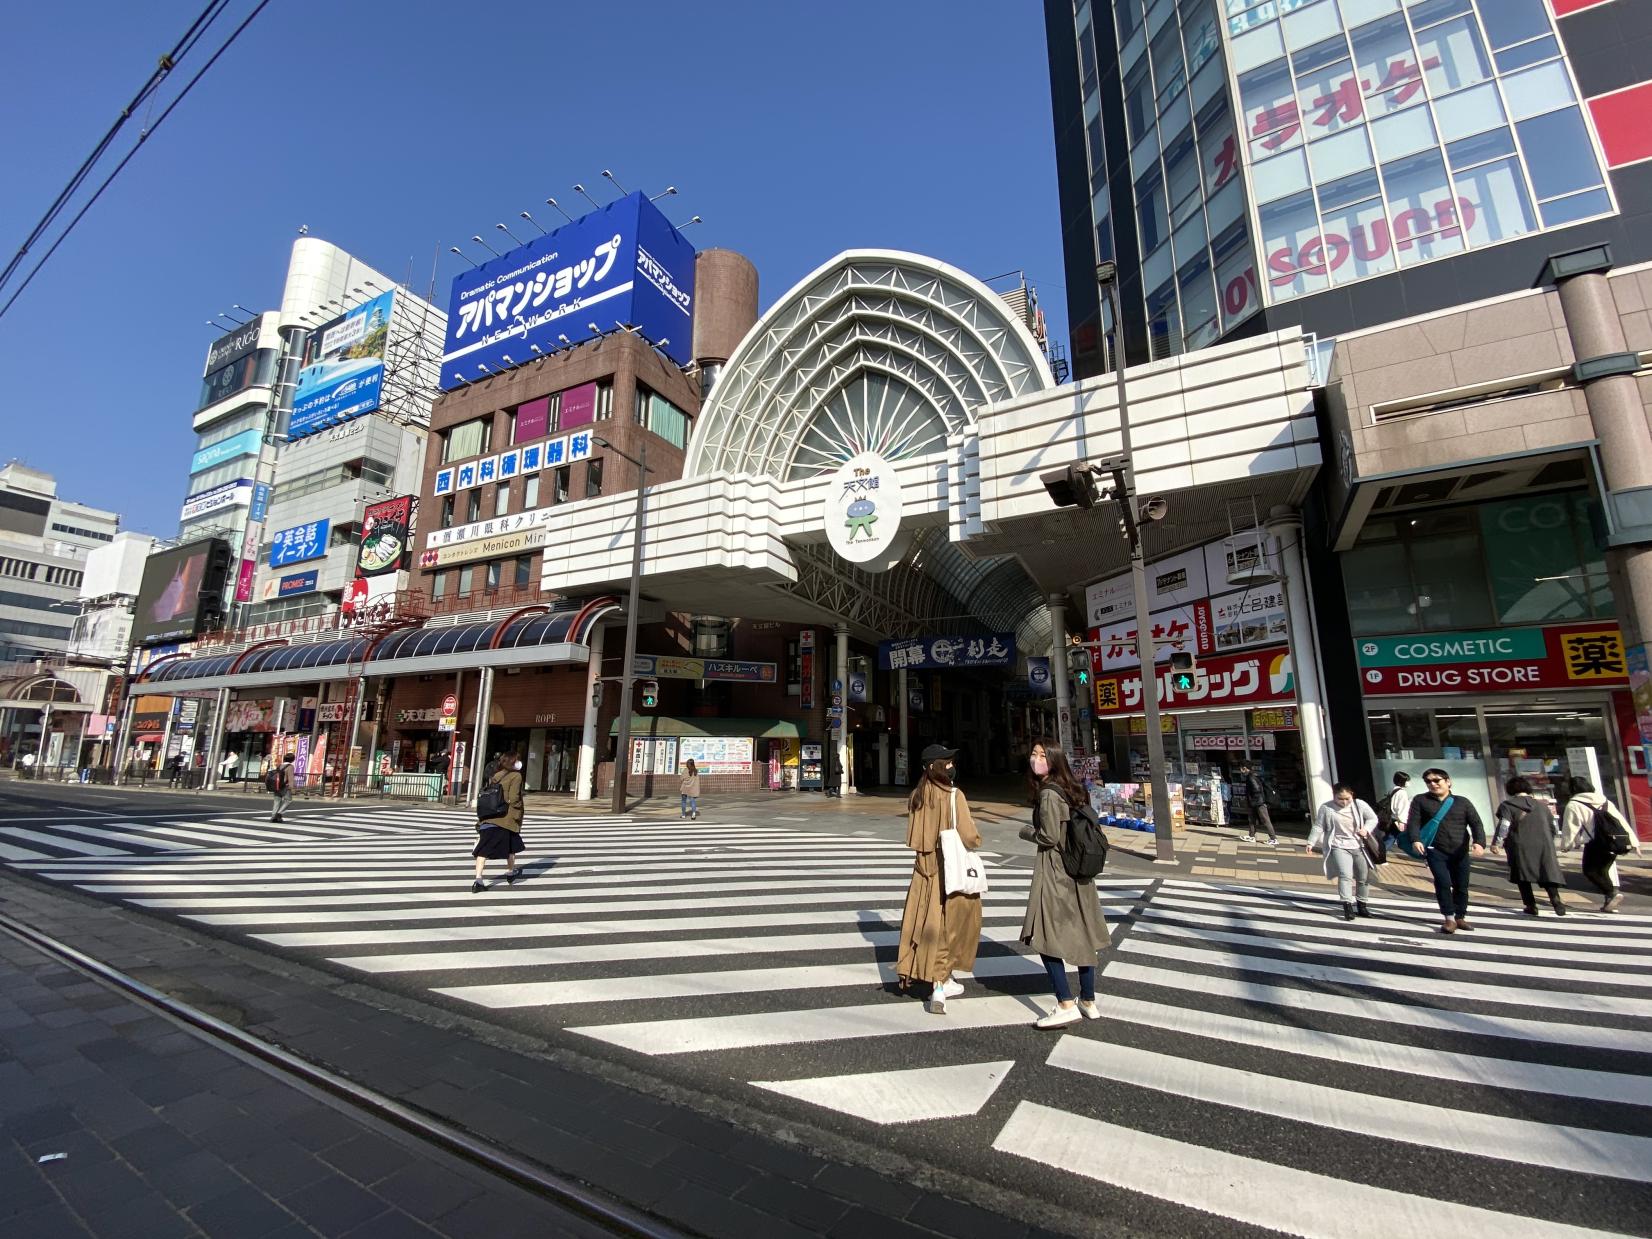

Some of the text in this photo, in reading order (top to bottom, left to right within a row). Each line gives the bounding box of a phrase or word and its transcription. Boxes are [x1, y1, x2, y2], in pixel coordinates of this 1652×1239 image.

[456, 234, 622, 339] アパマンショップ
[460, 251, 559, 300] Dramatic Communication
[637, 249, 691, 308] アパマンショップ
[436, 432, 589, 494] 西内科循環器科
[853, 467, 871, 477] The
[839, 475, 880, 502] 天文館
[282, 523, 318, 548] 英会話
[482, 538, 521, 553] Menicon
[277, 542, 319, 564] イーオン
[281, 578, 305, 590] PROMISE
[1198, 606, 1209, 650] JOYSOUND
[888, 644, 926, 670] 開幕
[1364, 638, 1513, 660] 2F COSMETIC
[1567, 635, 1624, 676] 薬
[708, 662, 759, 674] ハズキルーペ
[1368, 665, 1541, 687] 1F DRUG STORE
[1098, 682, 1117, 708] 薬
